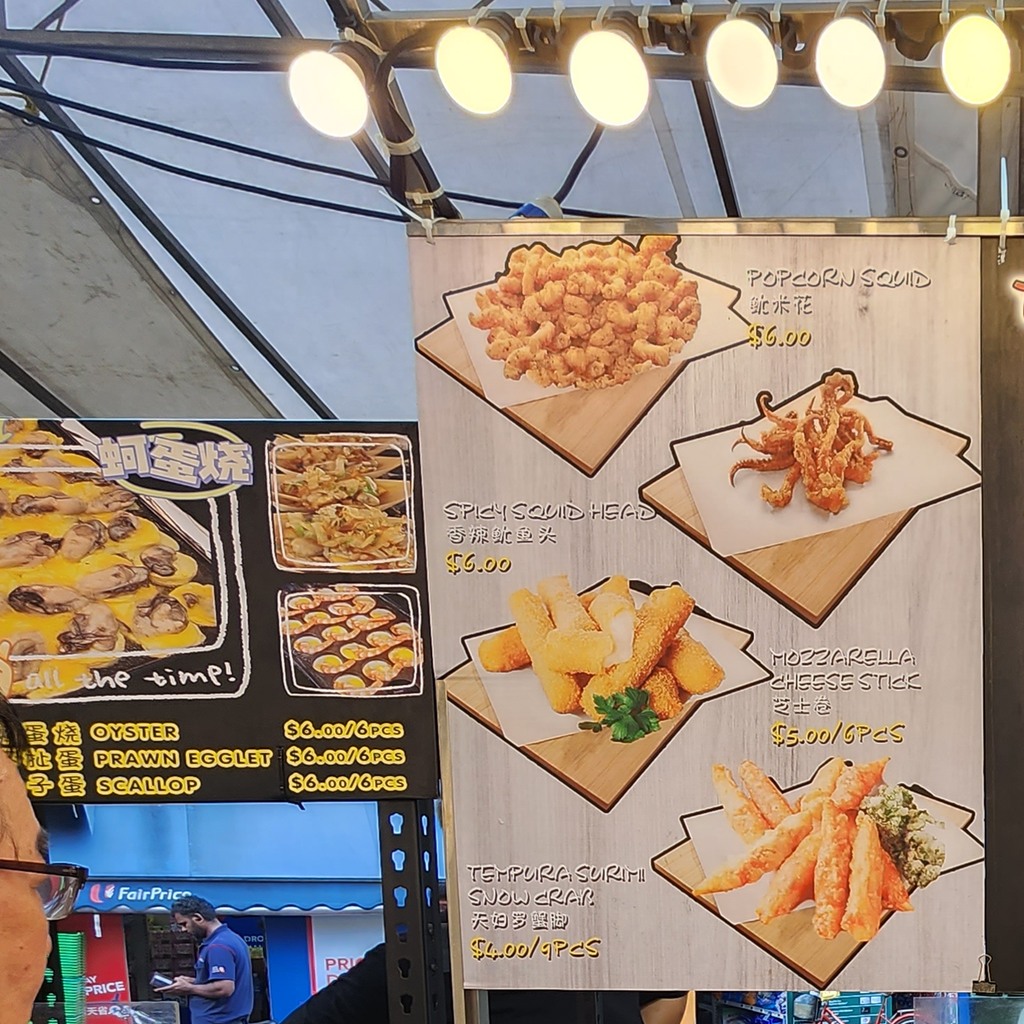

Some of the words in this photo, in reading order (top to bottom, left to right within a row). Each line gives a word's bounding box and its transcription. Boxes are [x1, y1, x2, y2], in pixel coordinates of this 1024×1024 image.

[747, 268, 855, 288] POPCORN
[860, 268, 932, 288] SQUID
[747, 323, 813, 349] $6.00
[98, 434, 253, 488] 蚵蛋烧
[443, 501, 507, 522] SPICY
[511, 501, 585, 521] SQUID
[589, 501, 658, 521] HEAD
[446, 526, 558, 545] 香辣鱿鱼头
[445, 551, 512, 575] $6.00
[770, 647, 916, 667] MOZZARELLA
[24, 668, 65, 690] all
[75, 669, 131, 690] the
[770, 673, 854, 691] CHEESE
[858, 673, 922, 691] STICK
[0, 720, 83, 746] 蛋烧
[90, 722, 180, 741] OYSTER
[284, 719, 404, 740] $6.00/6PCS
[771, 720, 906, 748] $5.00/6PCS
[94, 749, 180, 768] PRAWN
[185, 749, 273, 768] EGGLET
[286, 746, 406, 766] $6.00/6PCS
[96, 776, 201, 795] SCALLOP
[288, 772, 408, 793] $6.00/6PCS
[466, 864, 572, 883] TEMPURA
[575, 864, 647, 883] SURIMI
[468, 887, 530, 907] SNOW
